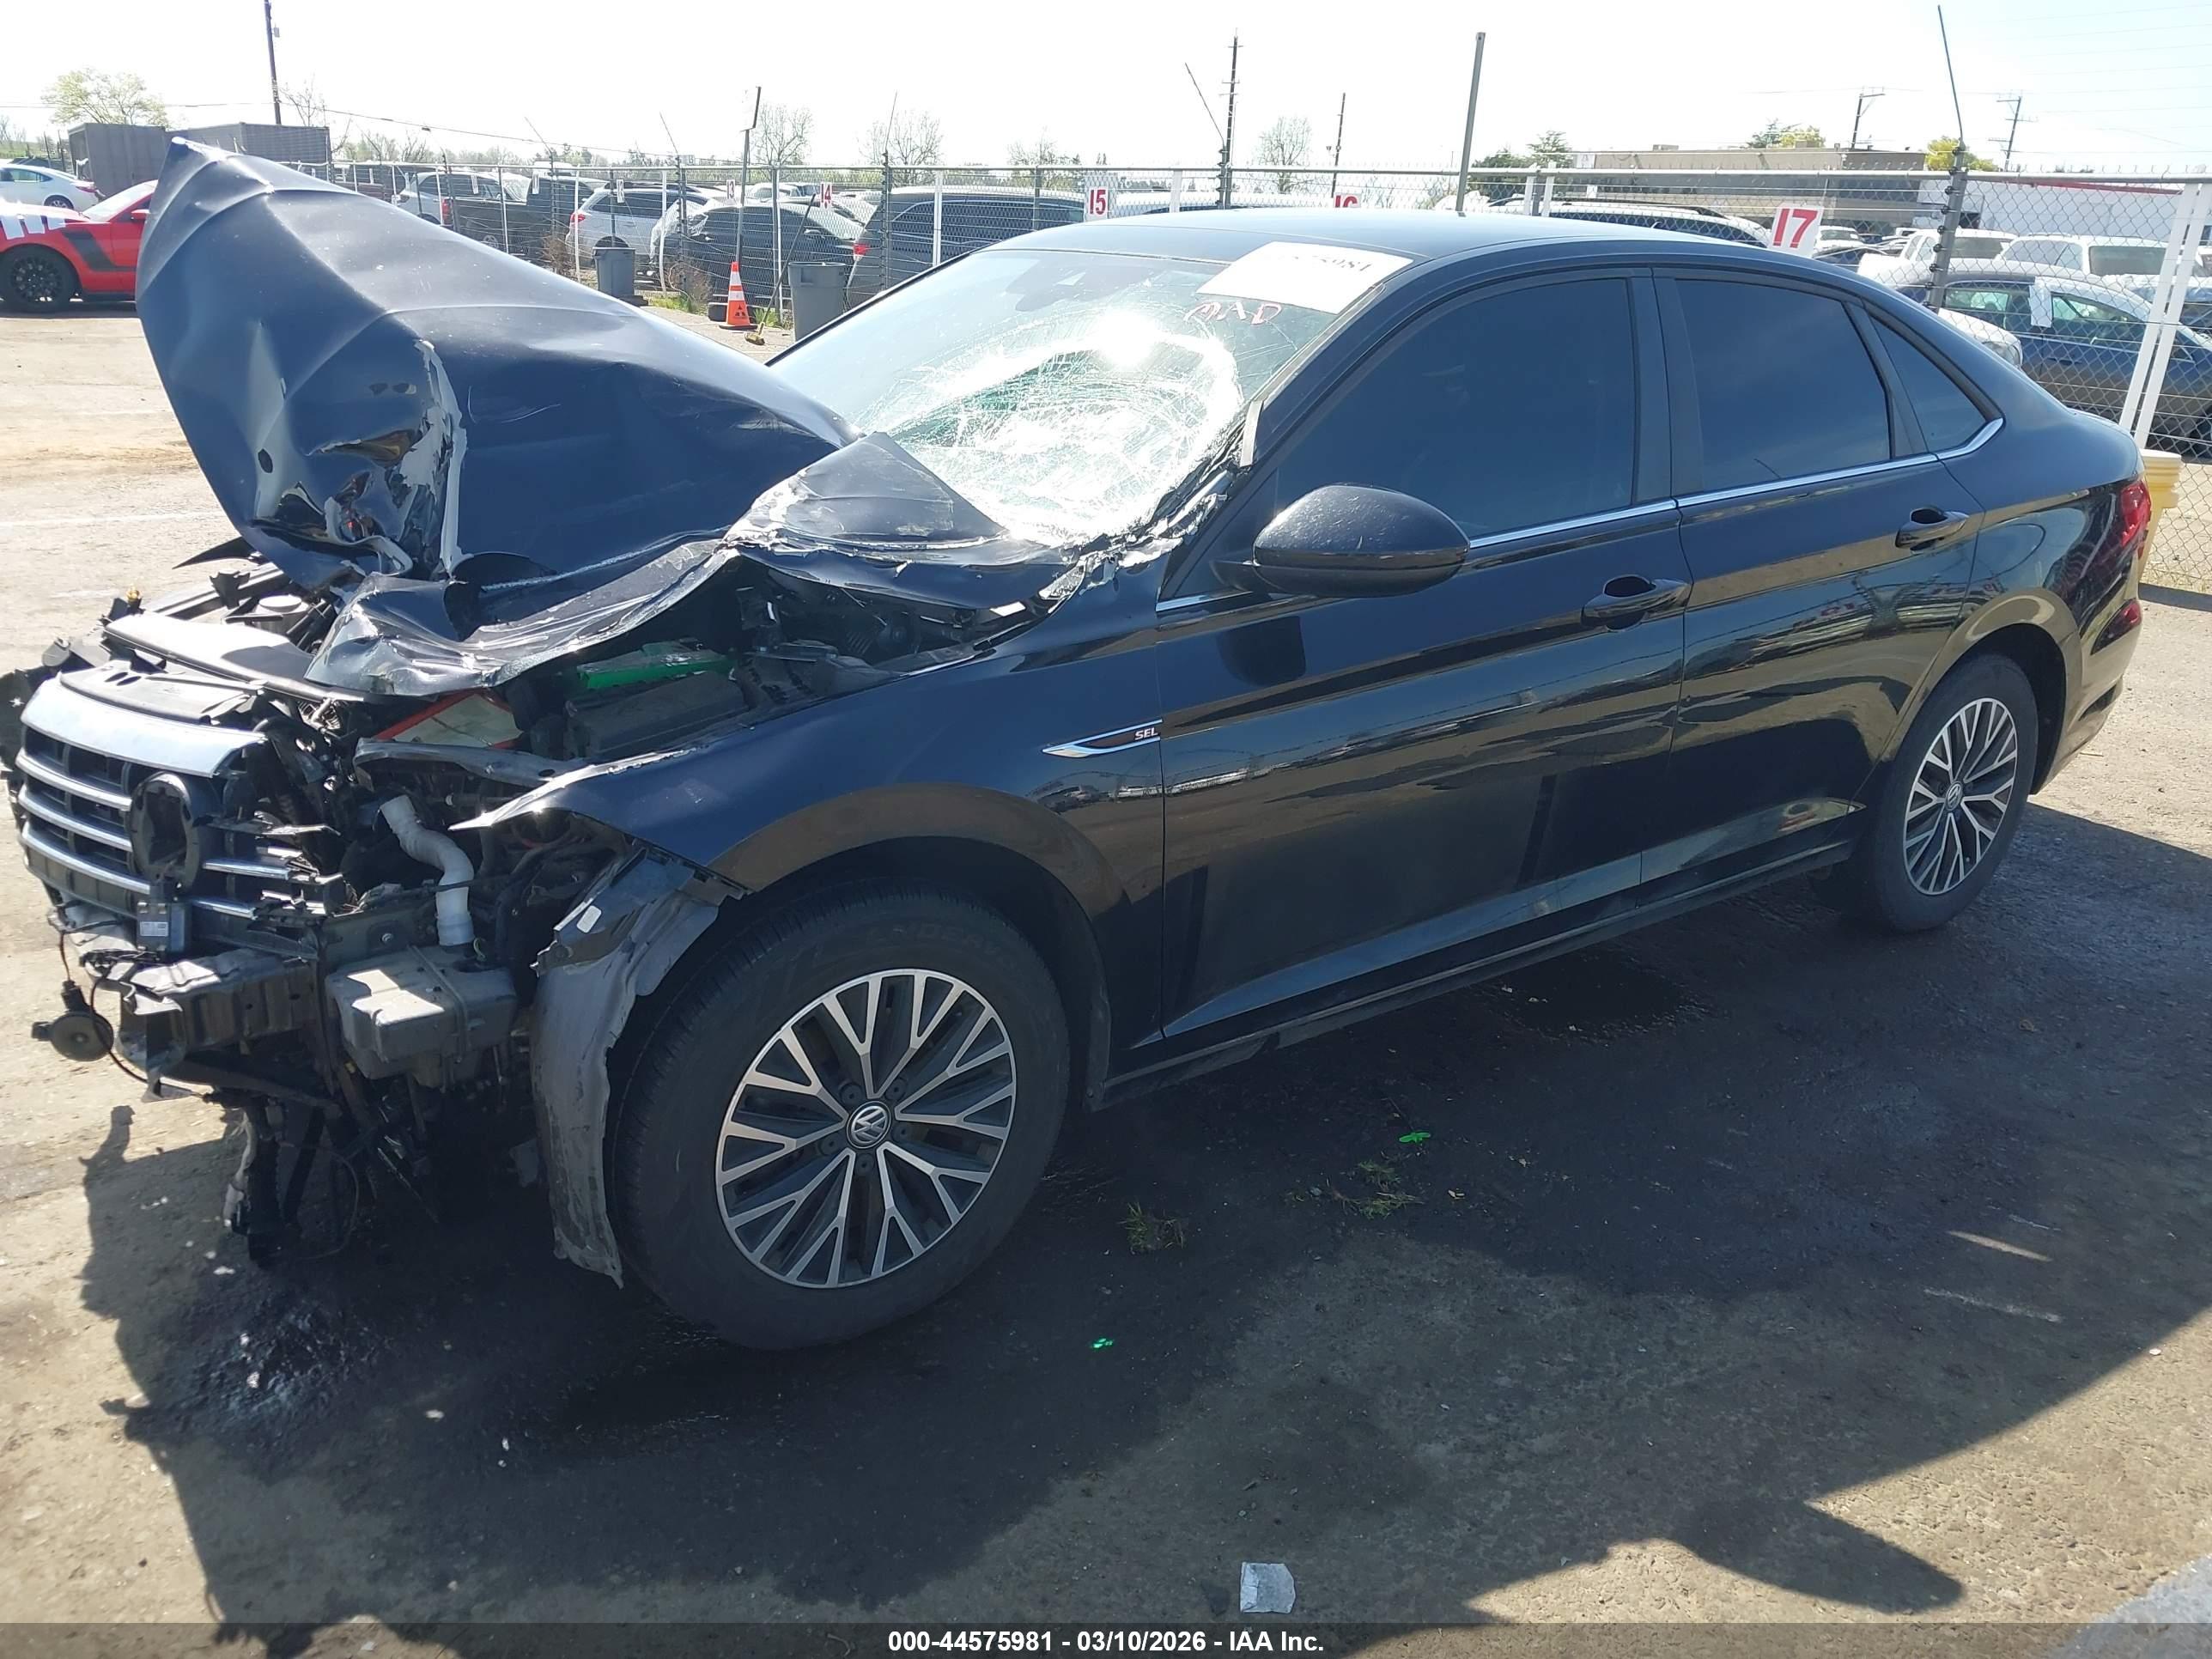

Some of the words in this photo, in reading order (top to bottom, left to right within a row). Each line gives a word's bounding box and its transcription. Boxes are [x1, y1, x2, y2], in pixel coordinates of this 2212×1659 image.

[821, 183, 831, 204] 14
[1089, 189, 1107, 215] 15
[1772, 208, 1818, 248] 17
[1134, 727, 1158, 740] SEL
